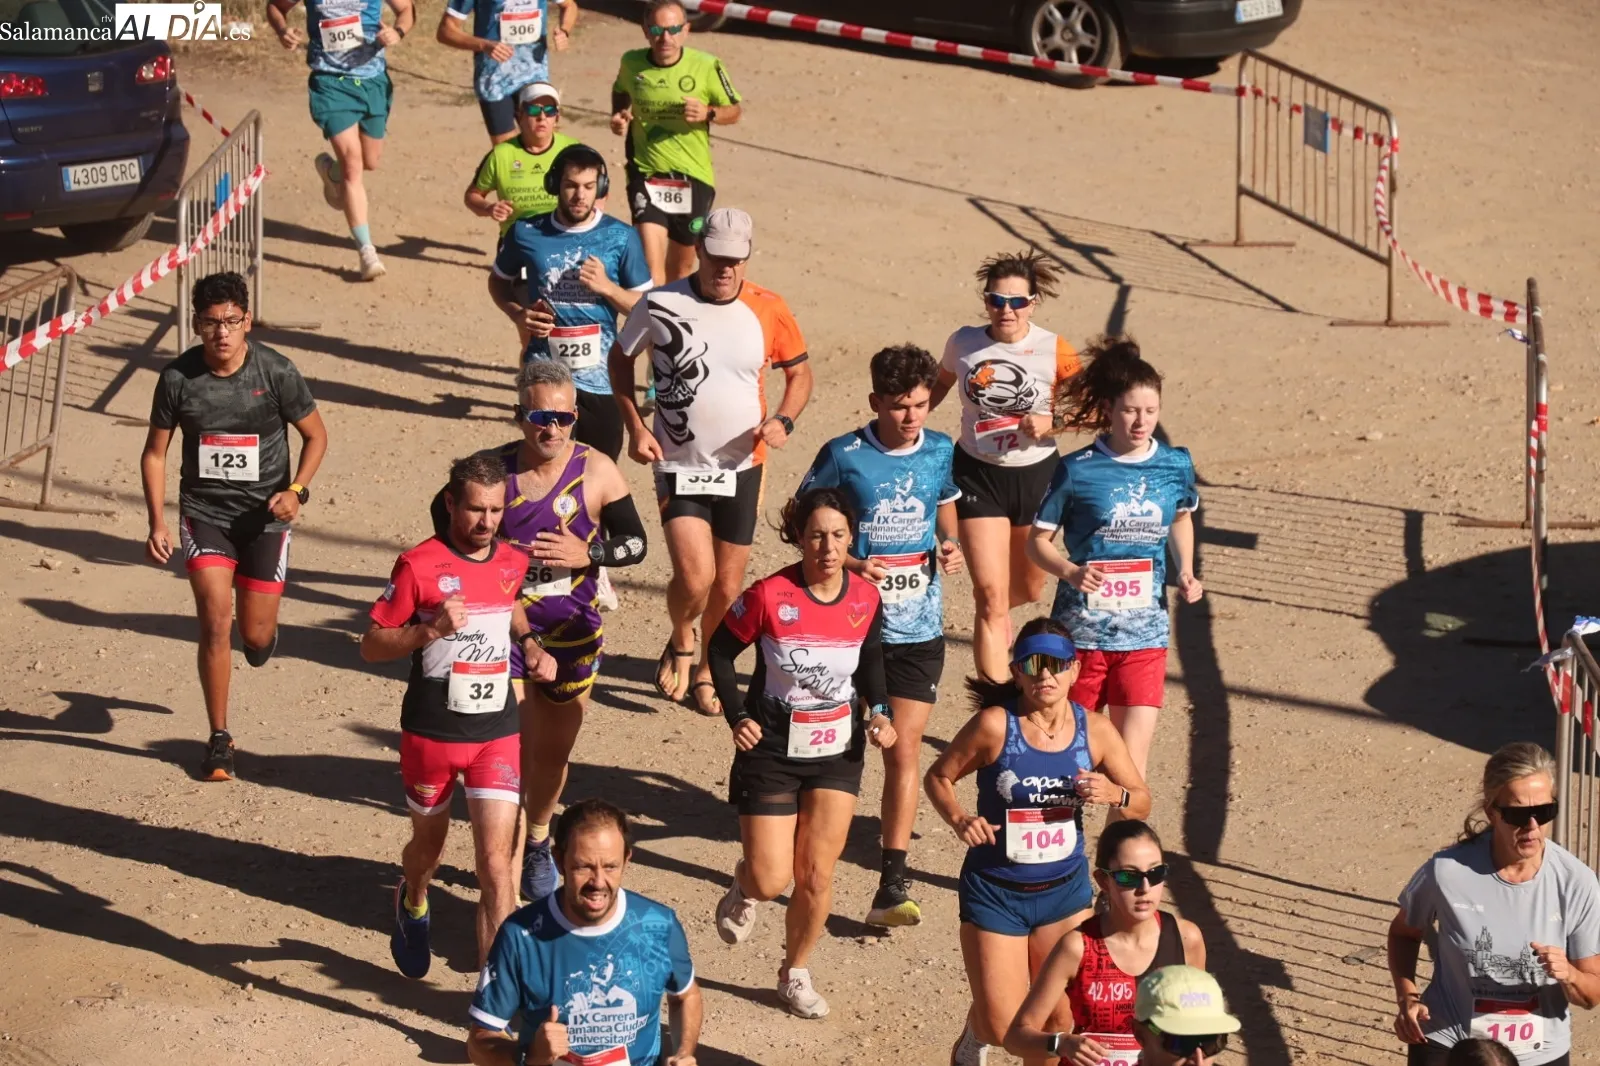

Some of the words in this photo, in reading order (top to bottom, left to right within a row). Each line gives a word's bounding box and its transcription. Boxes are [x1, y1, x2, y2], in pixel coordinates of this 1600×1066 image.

[329, 29, 355, 43] 305
[509, 24, 535, 36] 306
[73, 165, 108, 186] 4309
[111, 162, 137, 182] CRC
[559, 343, 591, 358] 228
[993, 433, 1019, 451] 72
[210, 453, 247, 469] 123
[877, 515, 890, 525] IX
[1114, 520, 1127, 528] IX
[525, 566, 553, 583] 56
[881, 573, 920, 591] 396
[1101, 580, 1141, 598] 395
[781, 648, 830, 676] Simón
[469, 682, 494, 700] 32
[809, 728, 837, 746] 28
[1022, 828, 1066, 850] 104
[1087, 981, 1133, 1003] 42,195
[573, 1013, 588, 1025] IX
[592, 1012, 635, 1023] Carrera
[614, 1016, 647, 1033] Ciudad
[568, 1032, 636, 1045] Universitaria
[1487, 1022, 1534, 1042] 110
